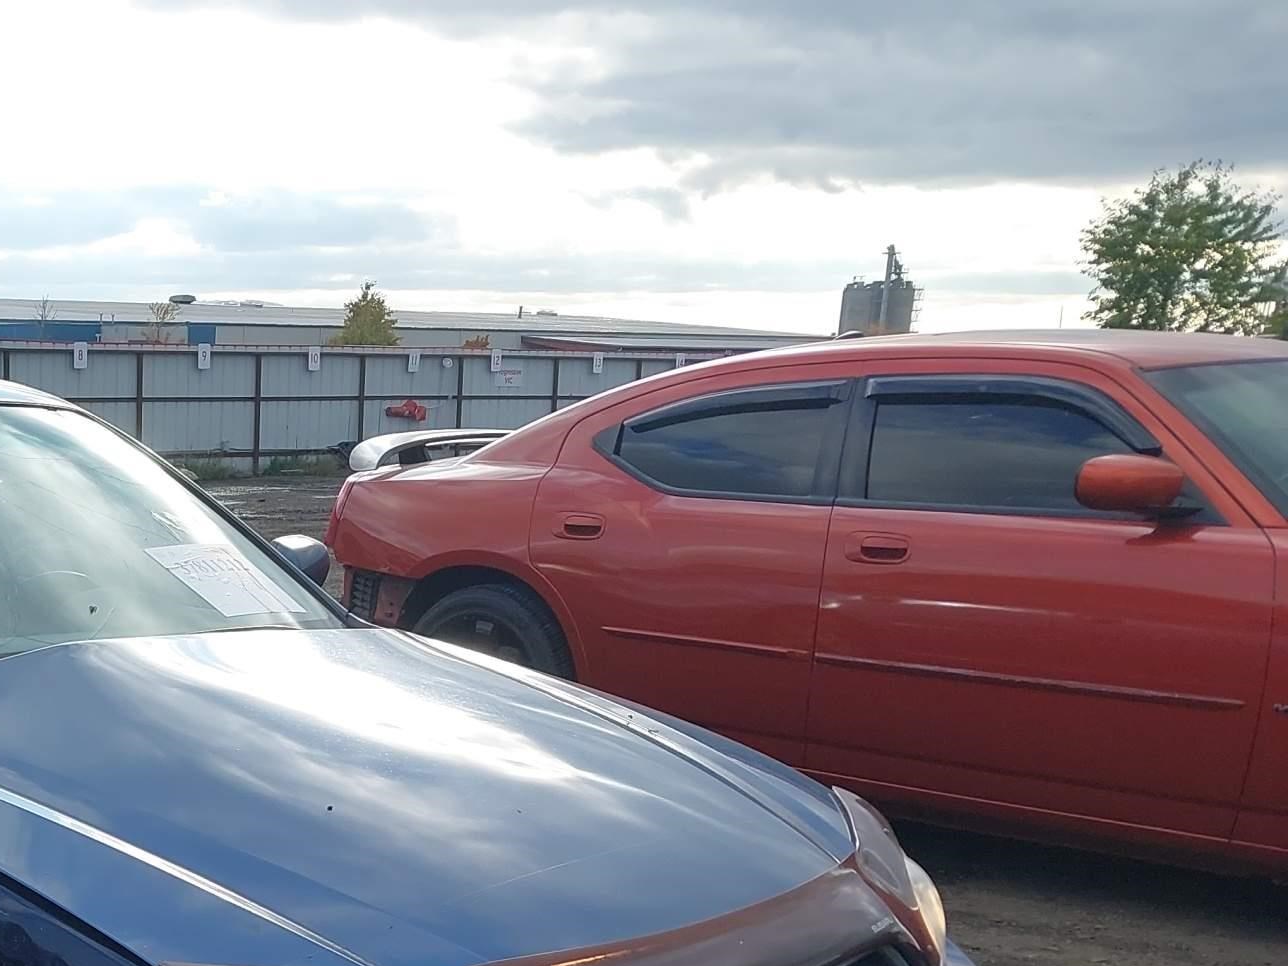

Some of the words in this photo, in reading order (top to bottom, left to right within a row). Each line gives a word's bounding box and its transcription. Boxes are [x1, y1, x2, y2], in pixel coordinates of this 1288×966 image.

[78, 350, 83, 361] 8
[201, 350, 207, 361] 9
[309, 351, 319, 364] 10
[493, 355, 500, 366] 12
